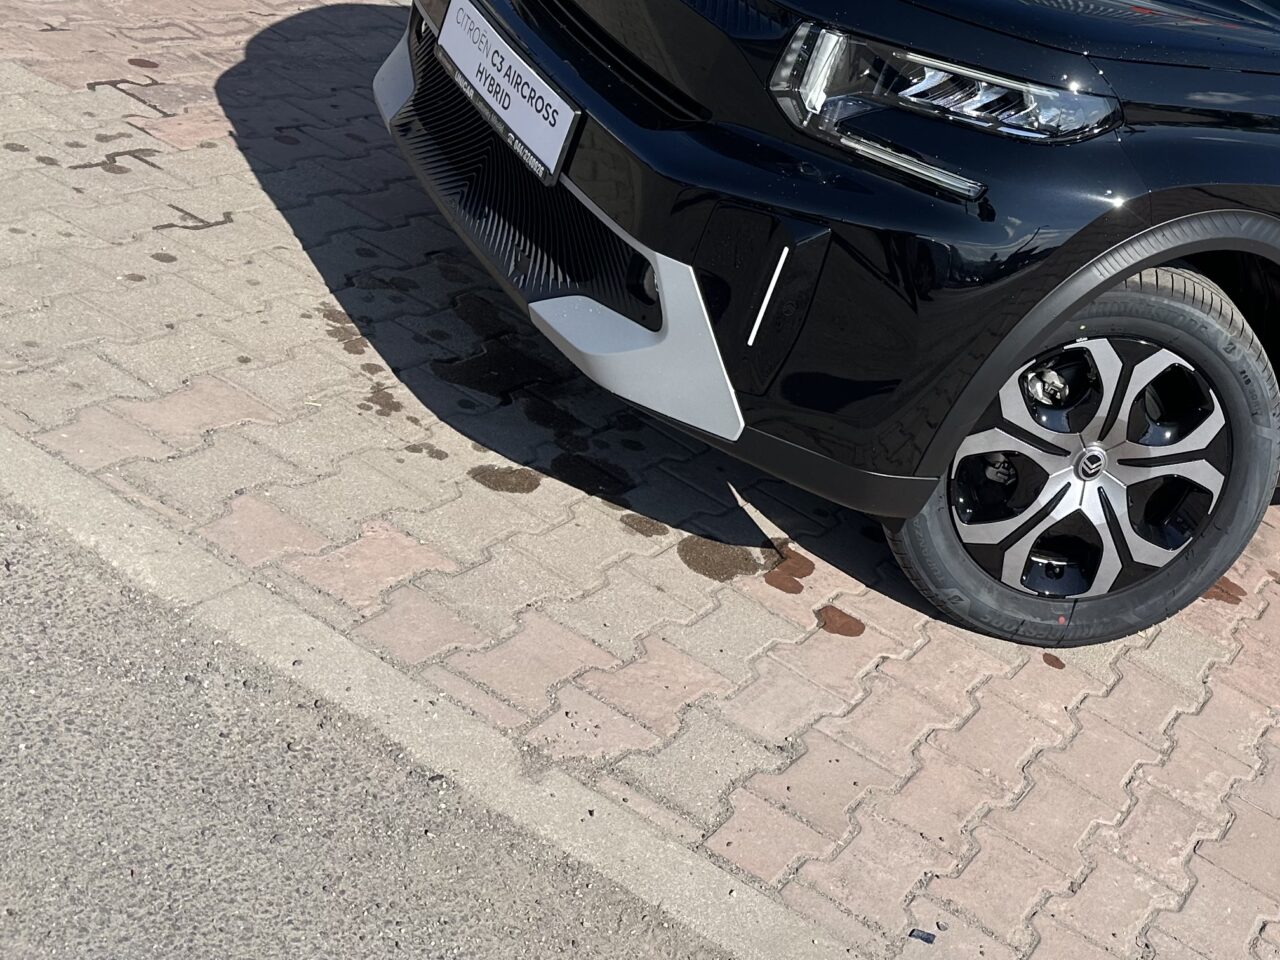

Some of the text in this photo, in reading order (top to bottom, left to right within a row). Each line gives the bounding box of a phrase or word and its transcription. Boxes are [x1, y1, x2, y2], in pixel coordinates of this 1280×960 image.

[476, 62, 511, 110] HYBRID
[490, 49, 506, 72] C3
[504, 64, 559, 127] AIRCROSS
